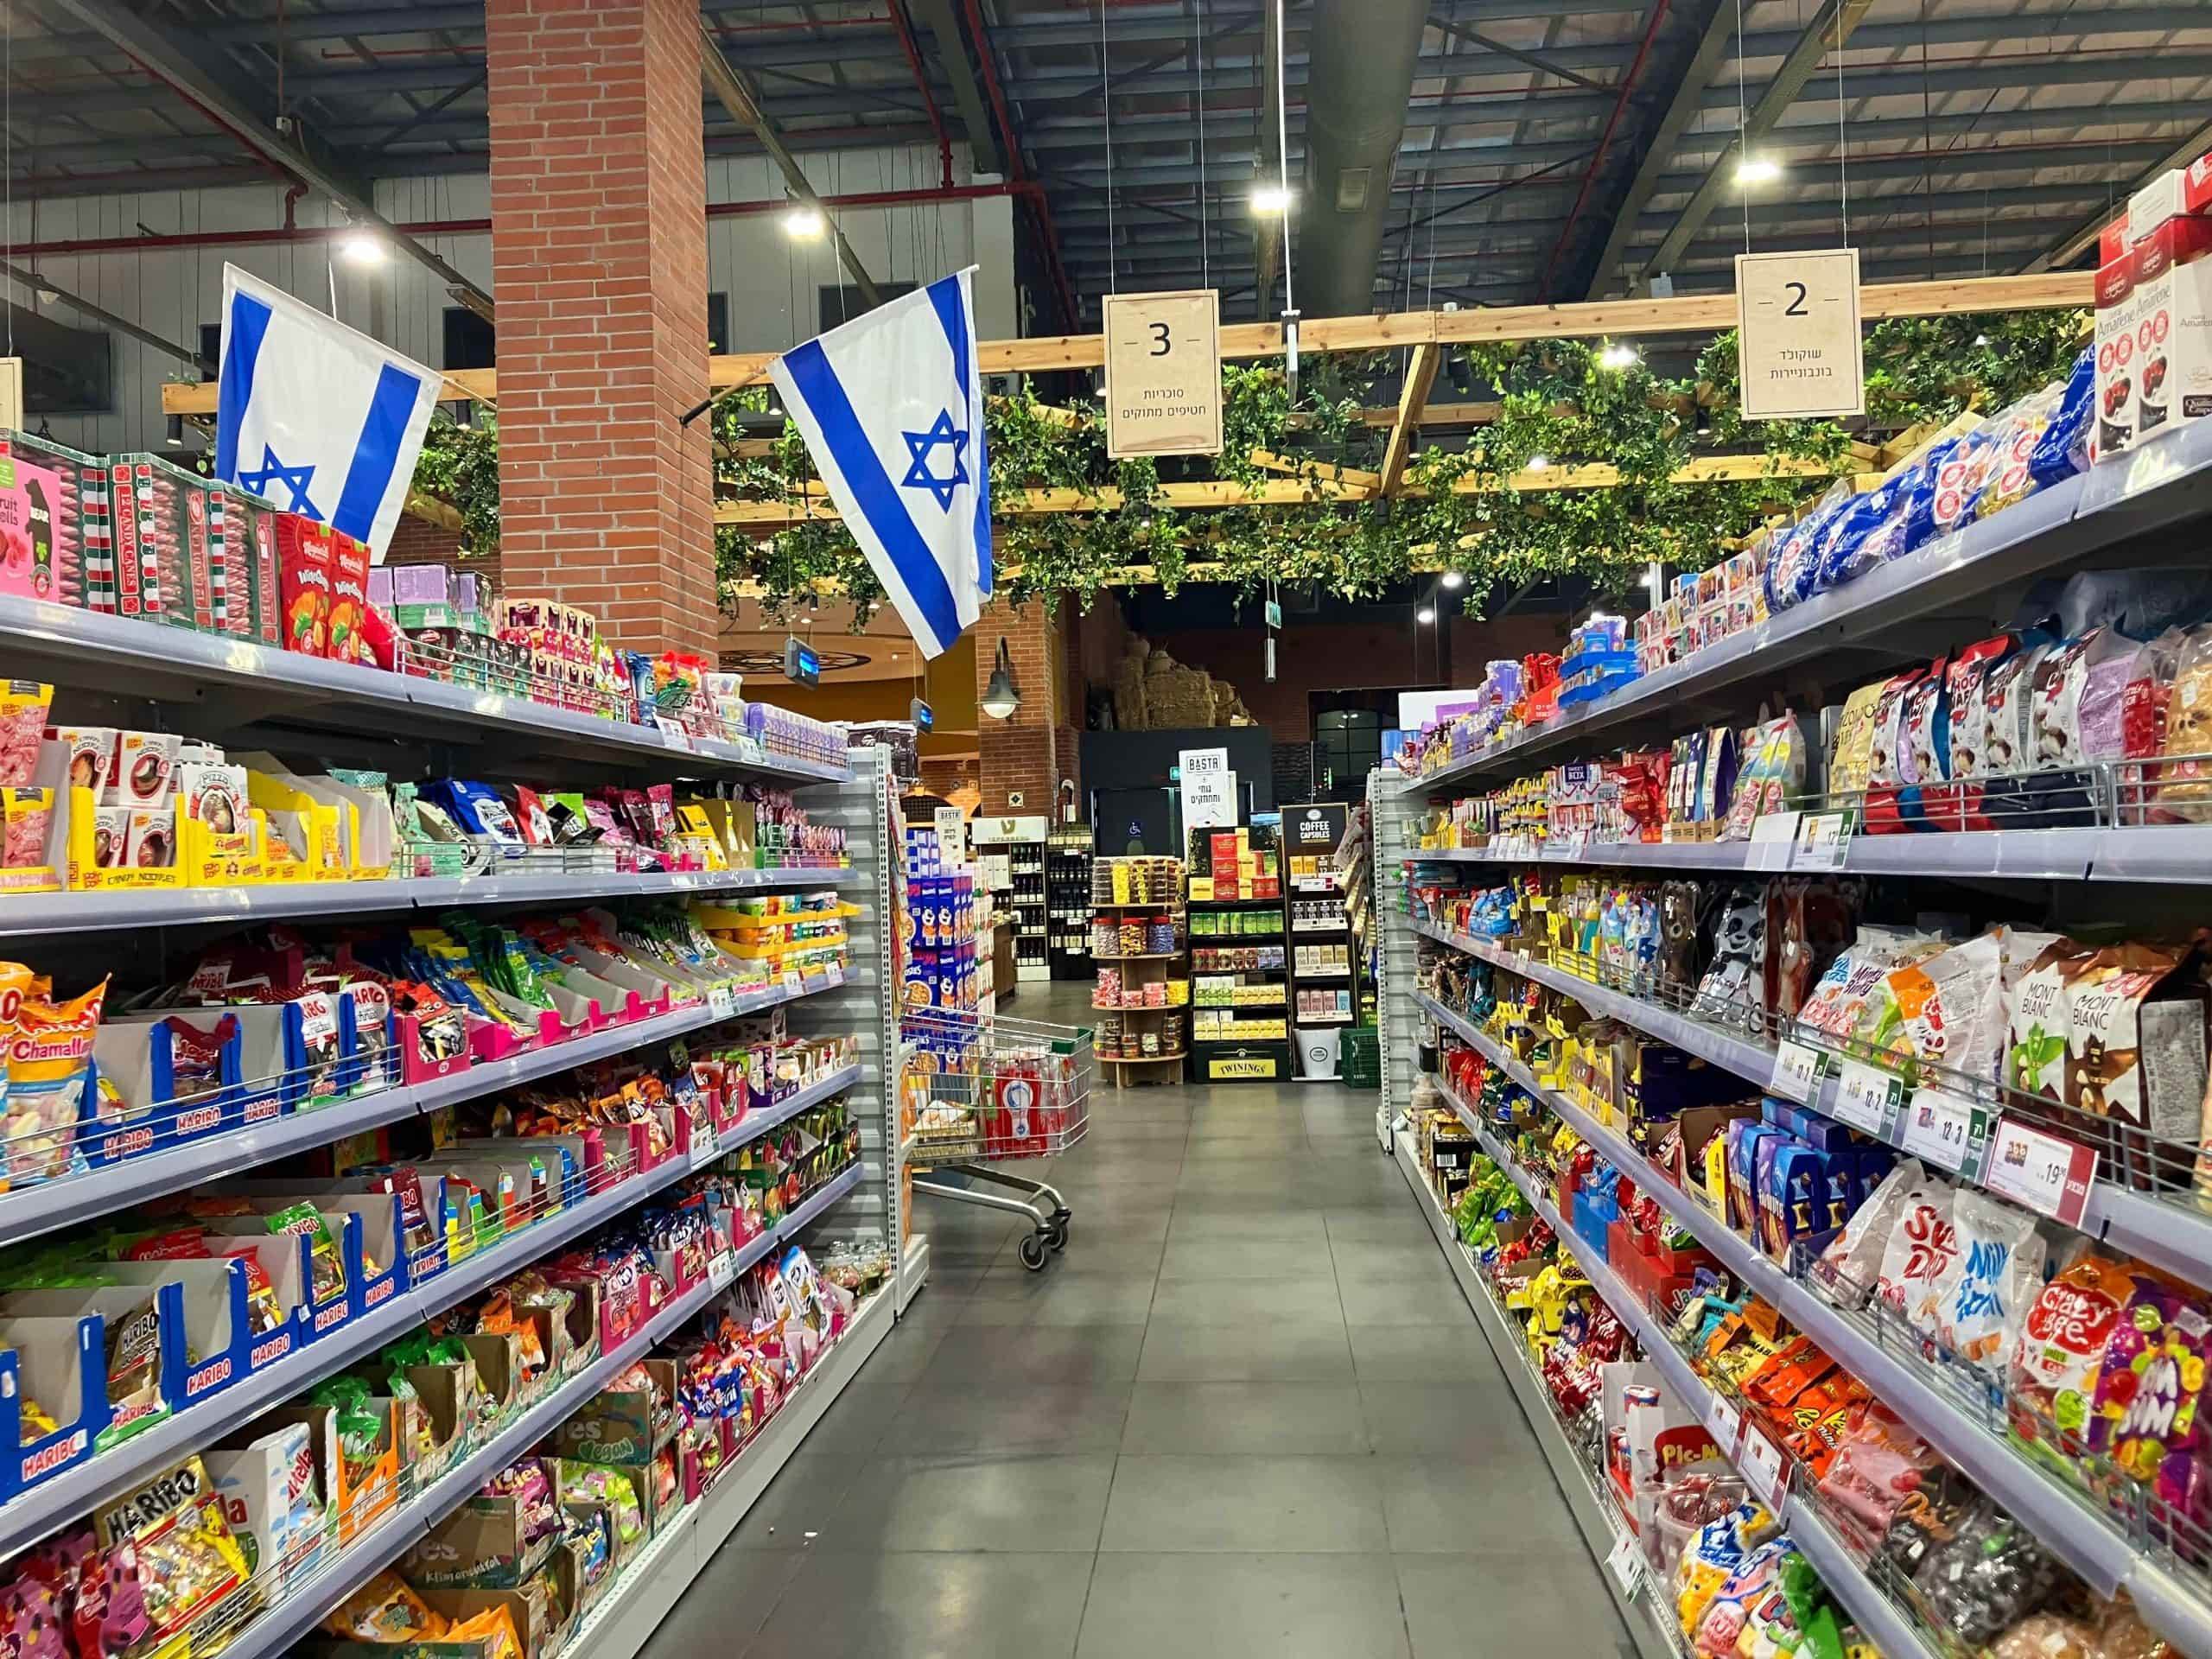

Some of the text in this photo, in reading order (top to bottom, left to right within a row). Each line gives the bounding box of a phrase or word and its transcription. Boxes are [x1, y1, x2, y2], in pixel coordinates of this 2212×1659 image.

[1785, 282, 1808, 316] 2
[1149, 322, 1172, 356] 3
[1779, 348, 1822, 363] שוקולד
[1770, 365, 1833, 380] בונבוניירות
[1143, 388, 1185, 401] סוכריות
[1122, 405, 1206, 422] חטיפים מתוקים
[1300, 821, 1331, 831] COFFEE
[2026, 981, 2058, 1001] MONT
[2021, 997, 2051, 1020] BLANC
[2073, 1010, 2109, 1031] BLANC
[1219, 1064, 1266, 1075] TWININGS
[177, 1107, 222, 1136] HARIBO
[365, 1278, 395, 1308] HARIBO
[2042, 1286, 2112, 1327] Crazy
[315, 1300, 349, 1333] HARIBO
[2043, 1310, 2088, 1344] Bee
[251, 1332, 291, 1367] HARIBO
[187, 1357, 232, 1397] HARIBO
[105, 1466, 201, 1547] HARIBO
